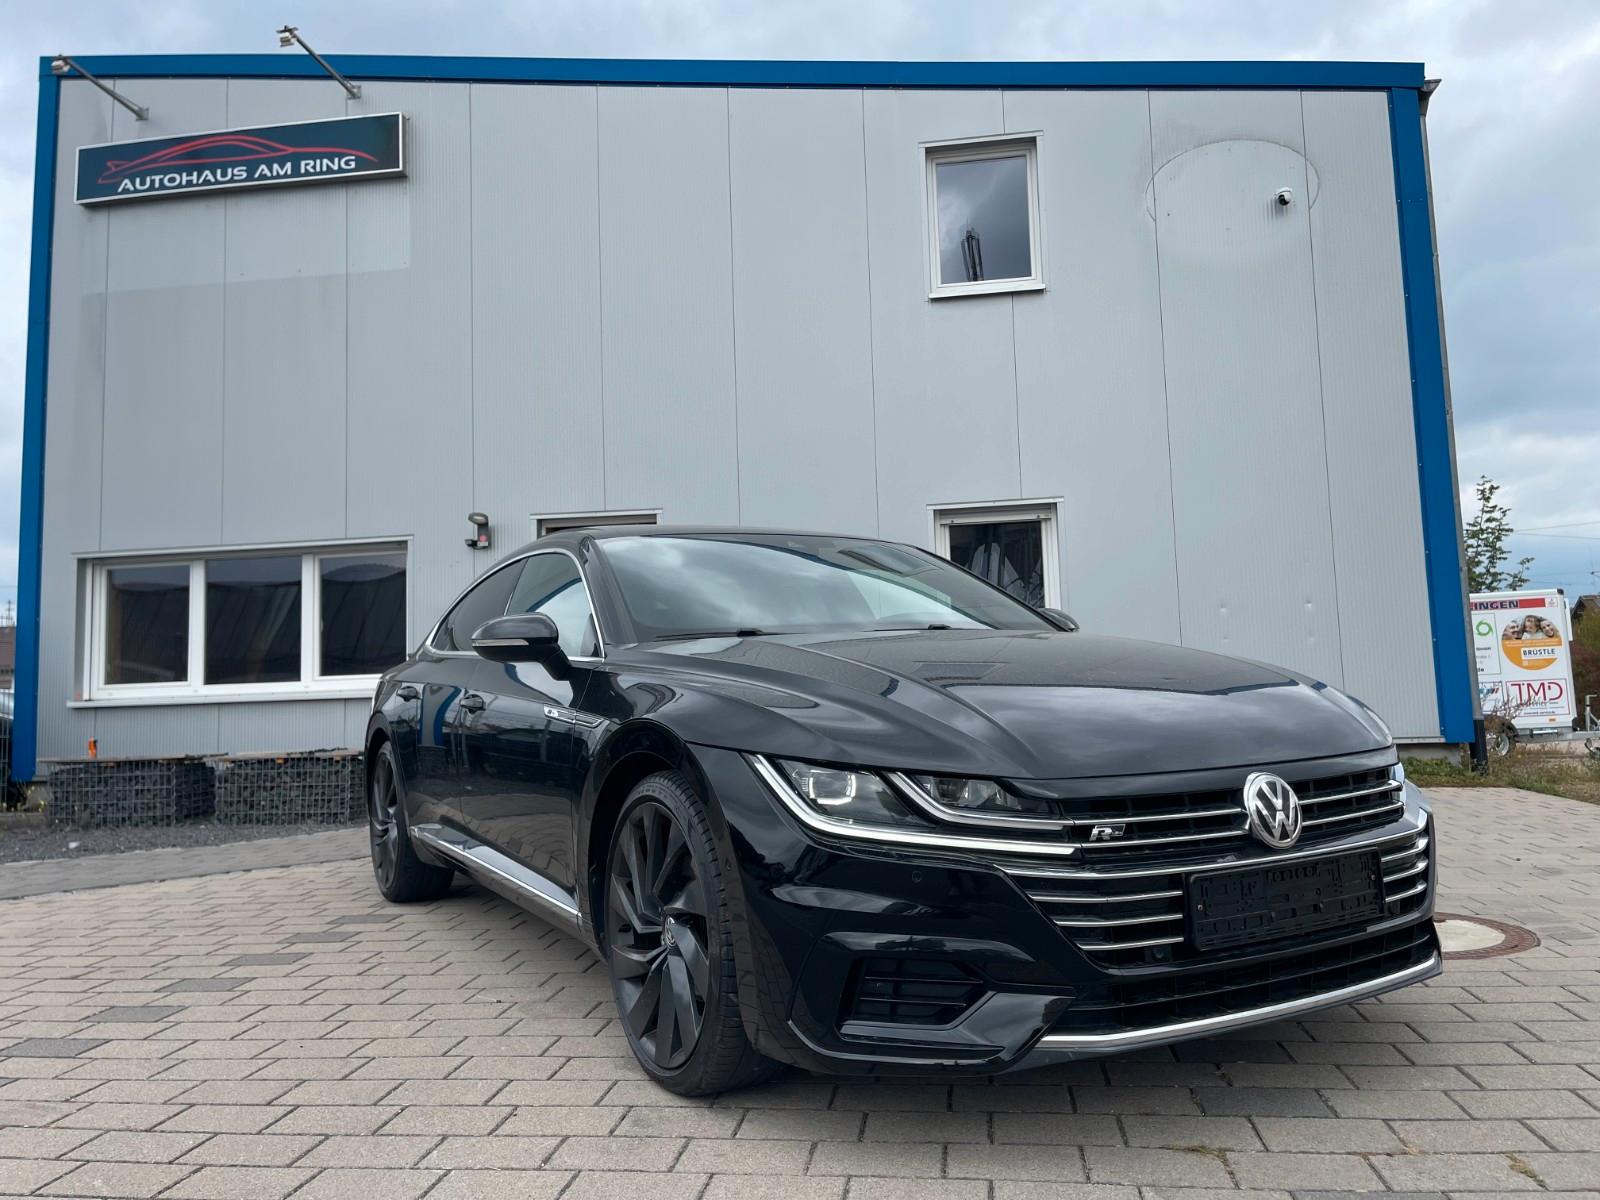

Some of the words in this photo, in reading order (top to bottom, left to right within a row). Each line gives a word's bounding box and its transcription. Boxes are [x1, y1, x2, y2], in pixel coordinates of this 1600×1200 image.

[117, 167, 247, 192] AUTOHAUS
[254, 162, 293, 179] AM
[300, 155, 356, 174] RING
[1471, 600, 1519, 610] INGEN
[1523, 648, 1556, 656] BRÜSTLE
